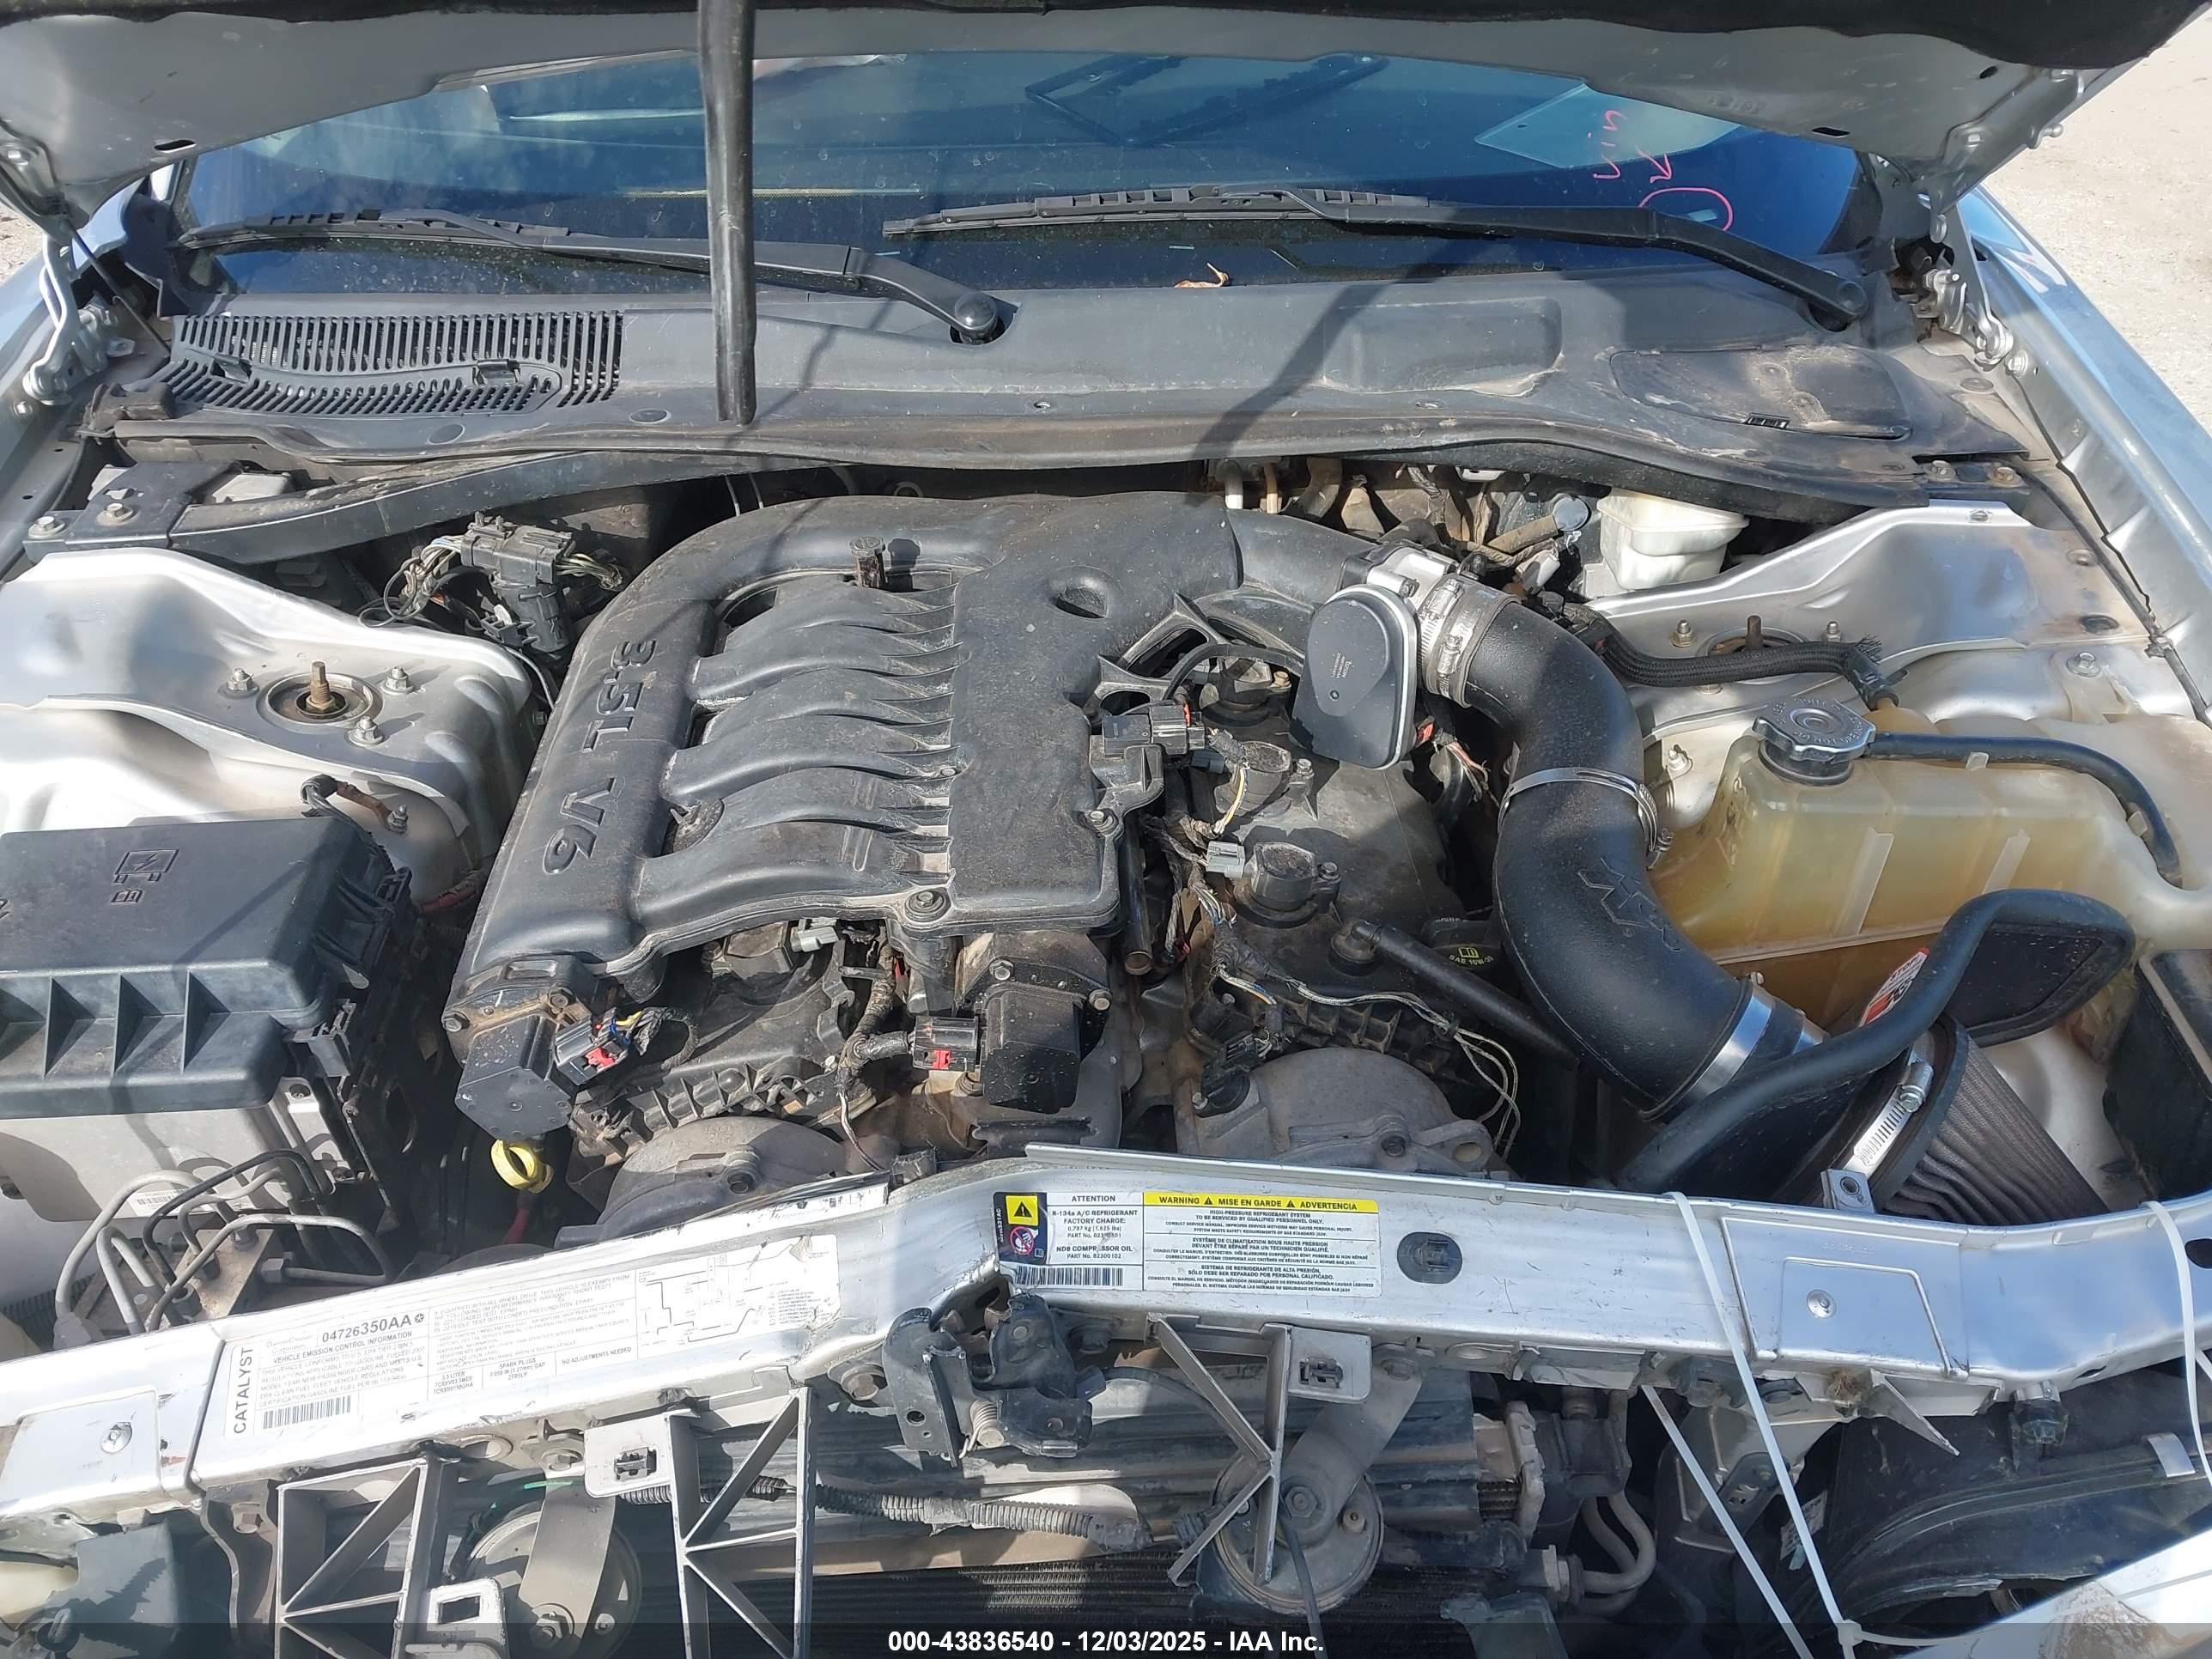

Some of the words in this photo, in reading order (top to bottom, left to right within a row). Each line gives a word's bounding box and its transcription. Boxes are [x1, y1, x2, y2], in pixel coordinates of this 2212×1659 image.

[542, 776, 617, 875] V6
[1160, 1196, 1200, 1205] WARNING
[1300, 1201, 1357, 1210] ADVERTENCIA
[322, 1314, 411, 1343] 04726350AA
[273, 1352, 301, 1364] VEHICLE
[303, 1346, 333, 1358] EMISSION
[335, 1340, 366, 1352] CONTROL
[368, 1331, 412, 1346] INFORMATION
[571, 1351, 610, 1364] ADJUSTMENTS
[611, 1346, 632, 1356] NEEDED
[500, 1361, 516, 1370] SPARK
[519, 1357, 536, 1365] PLUGS
[233, 1346, 254, 1434] CATALYST
